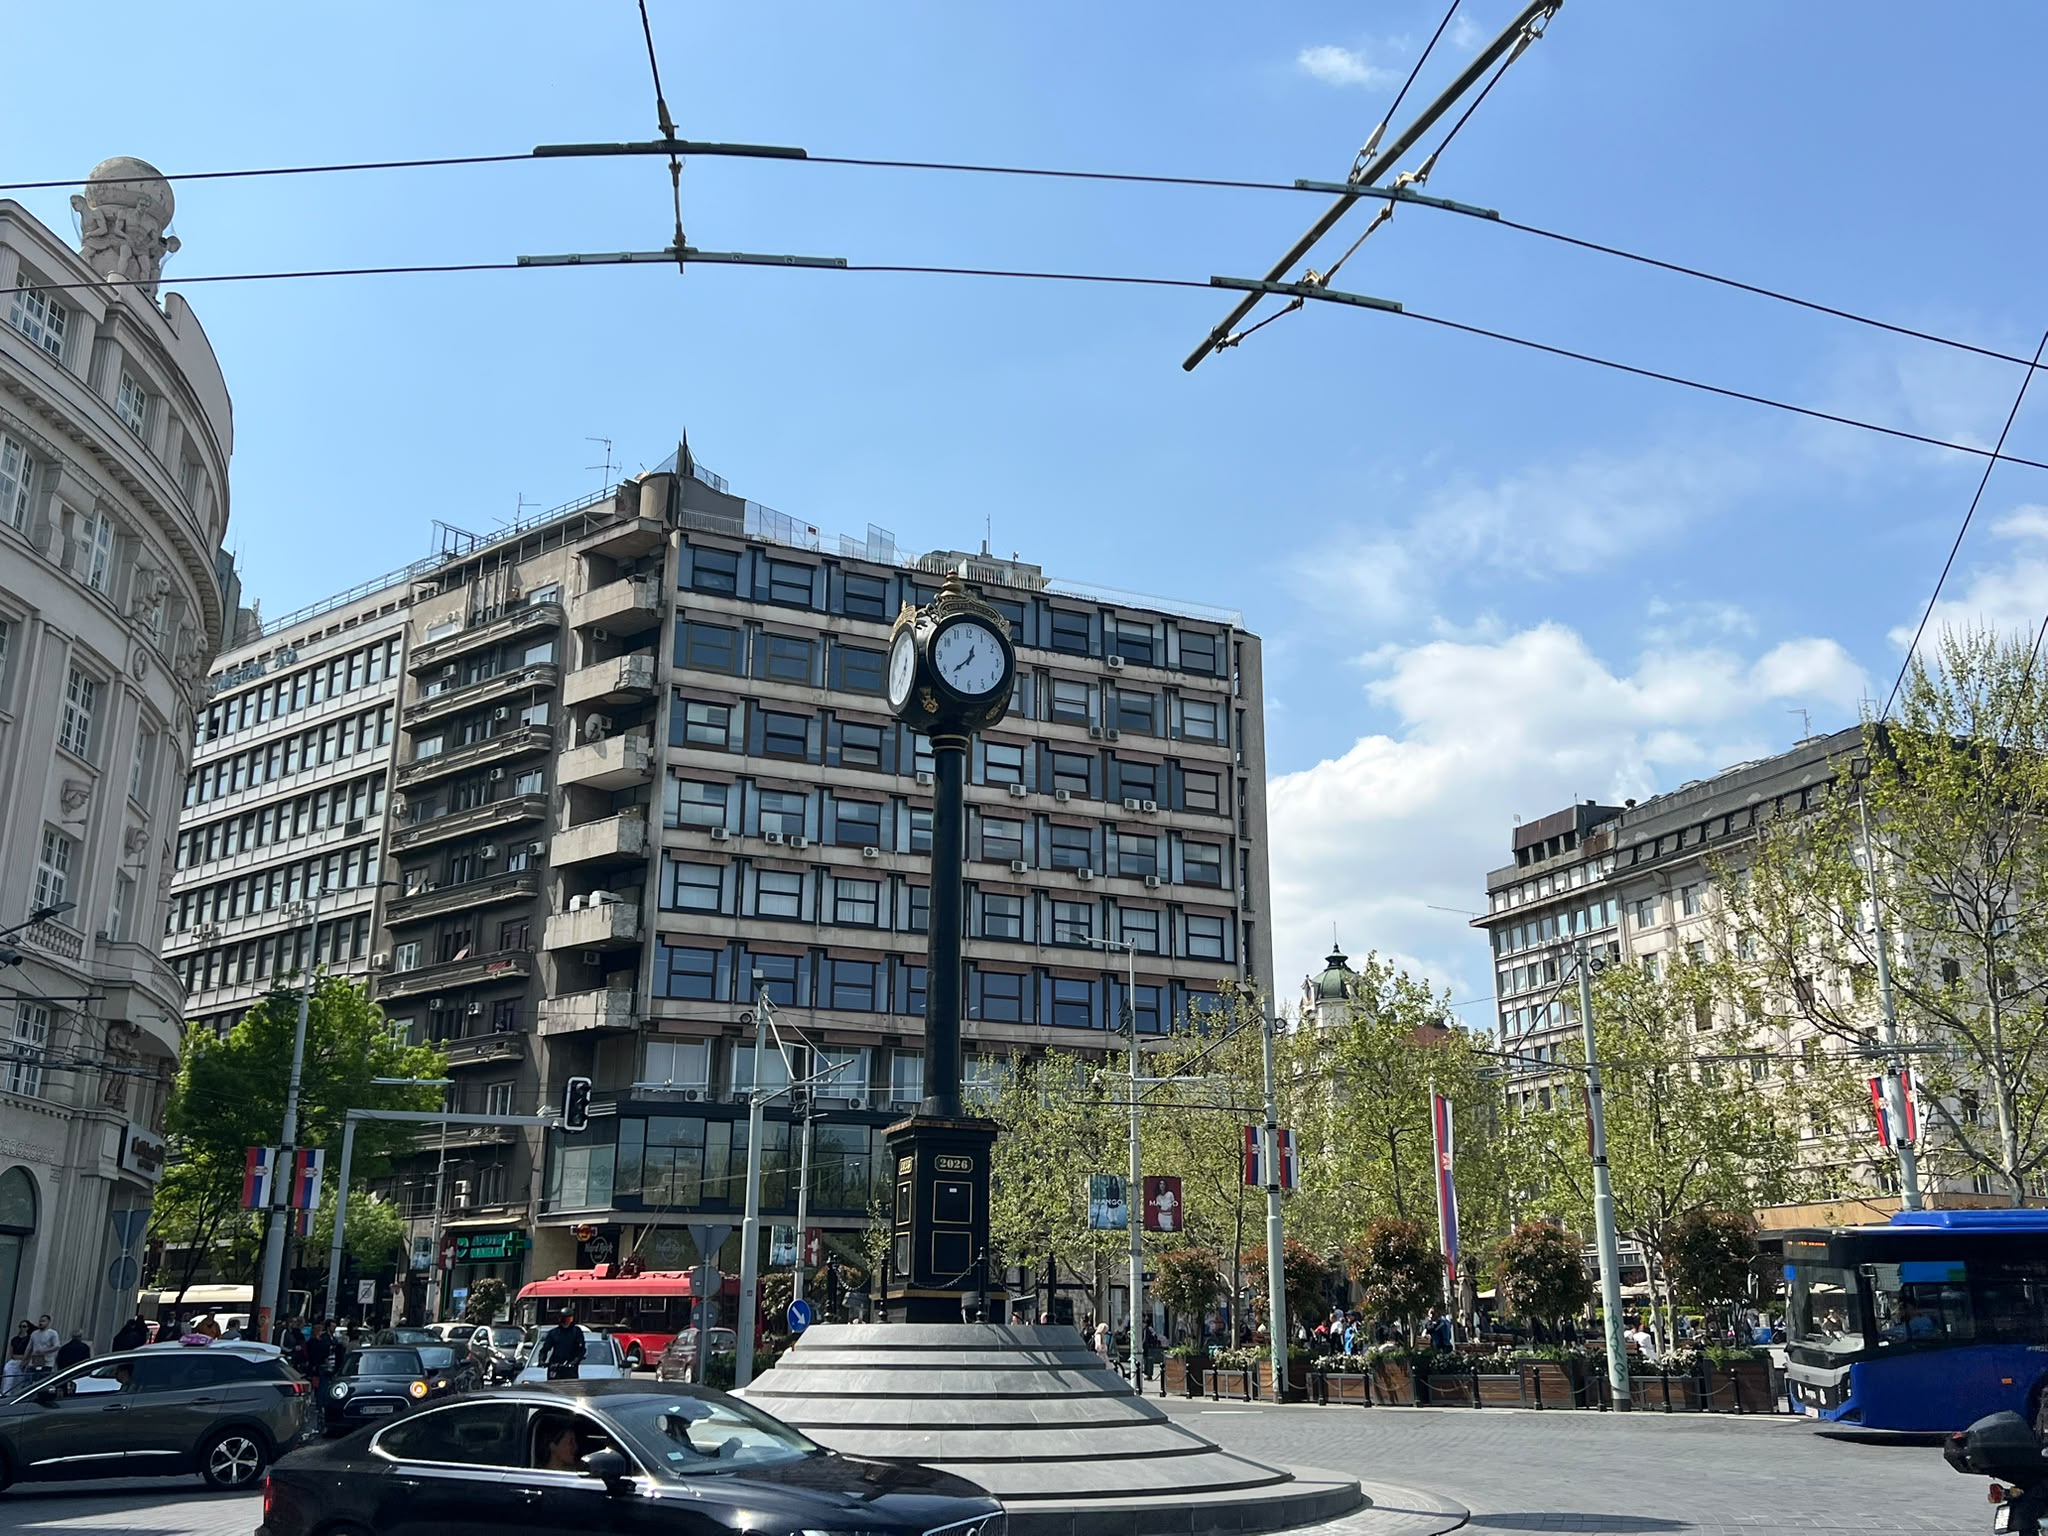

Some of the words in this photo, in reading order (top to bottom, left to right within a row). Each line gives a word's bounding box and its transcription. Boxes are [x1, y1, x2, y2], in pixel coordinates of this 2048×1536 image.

[952, 628, 960, 640] 11
[966, 628, 973, 639] 12
[944, 637, 951, 648] 10
[939, 1159, 968, 1169] 2026
[1094, 1198, 1123, 1206] MANGO
[1149, 1199, 1179, 1207] MAO
